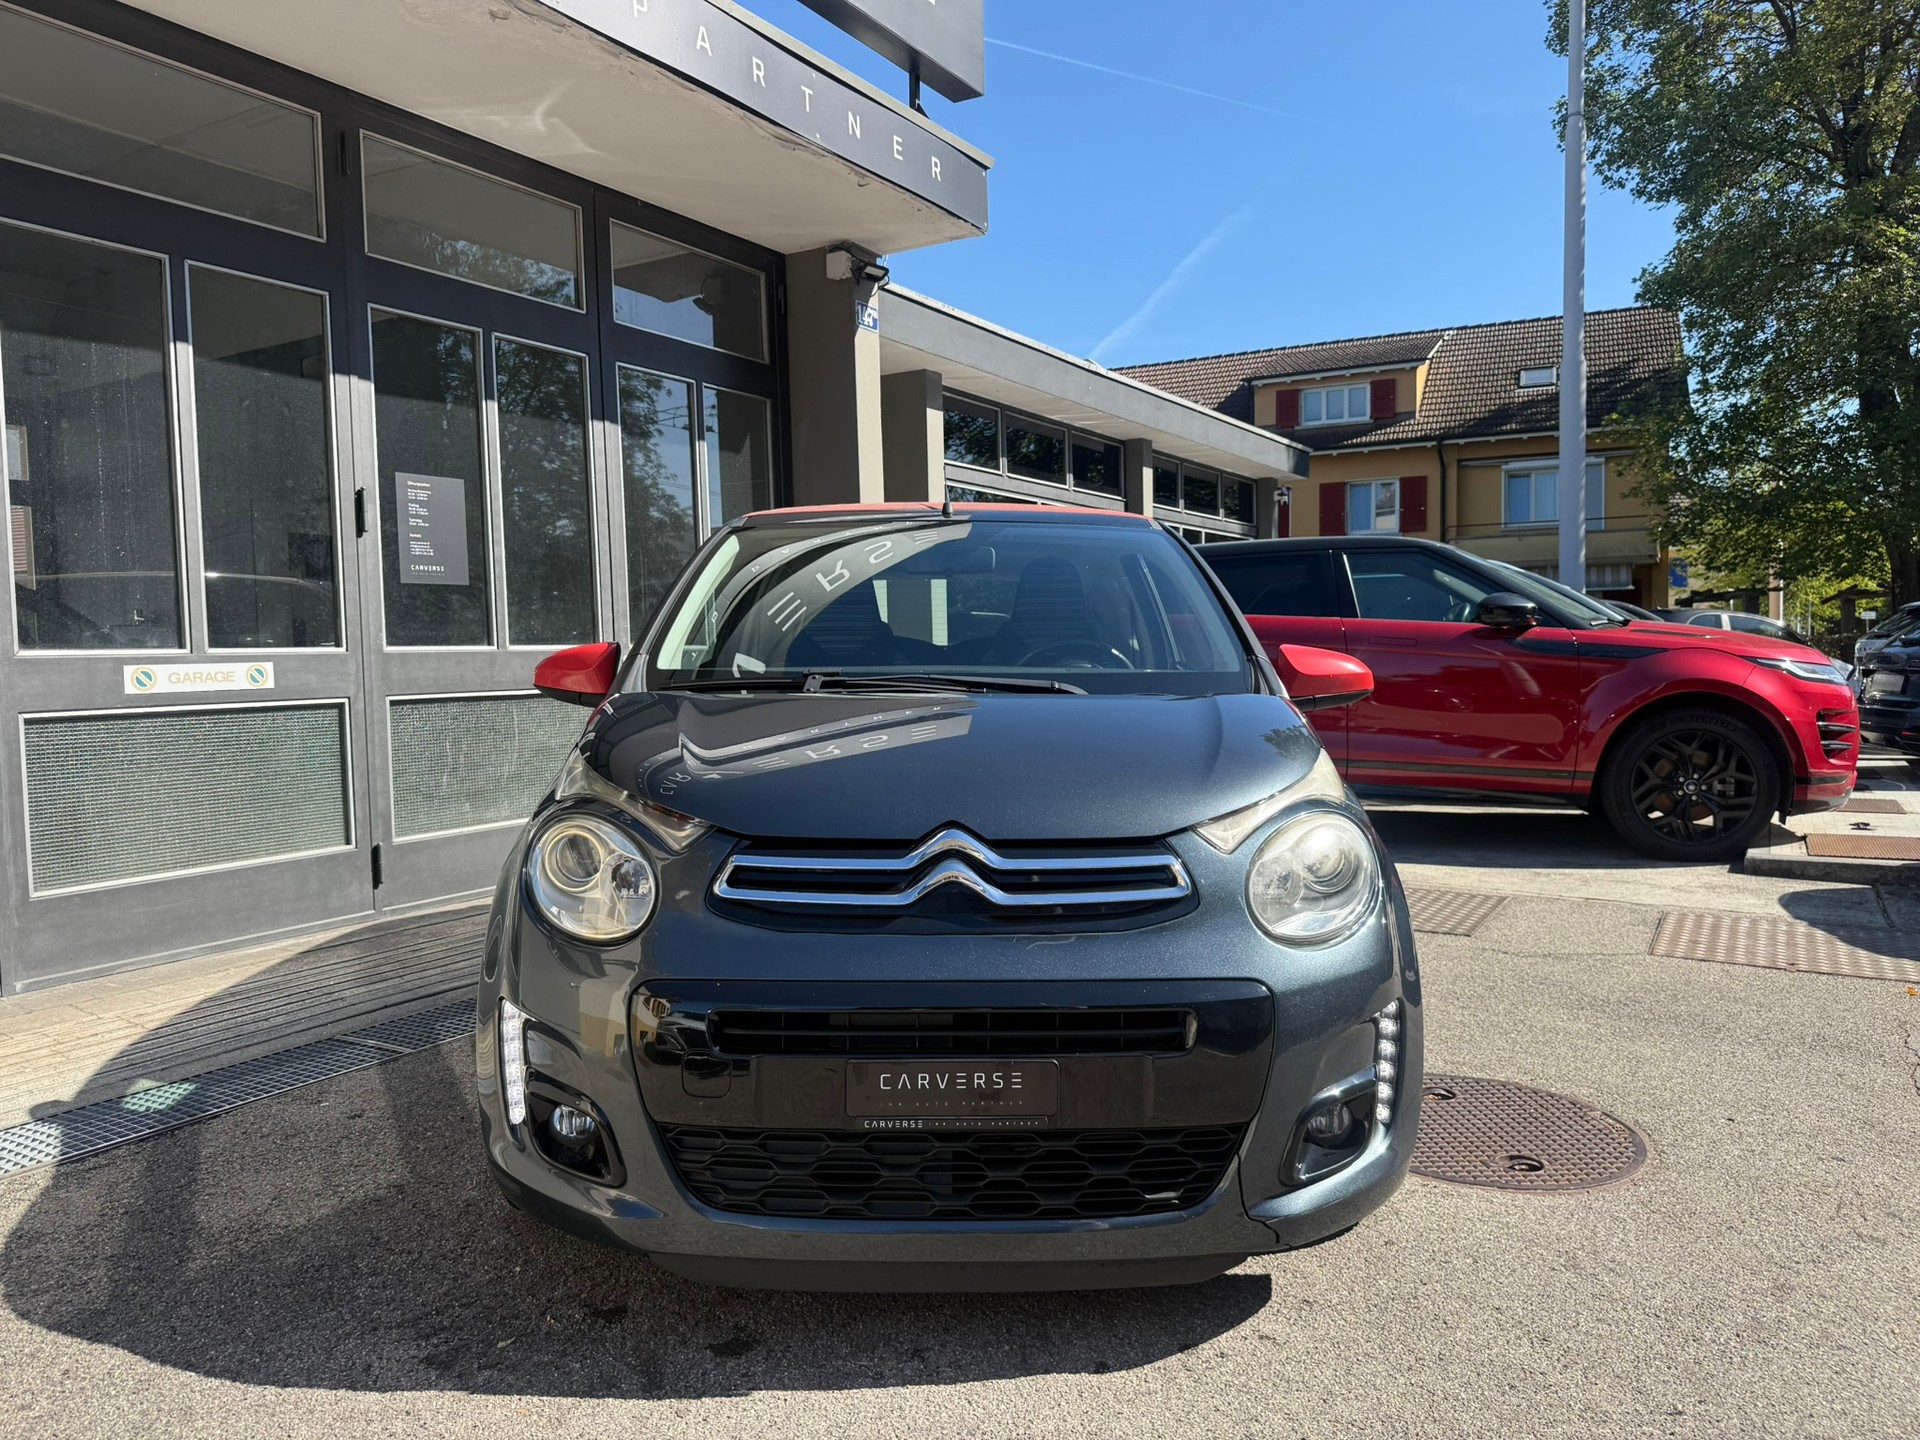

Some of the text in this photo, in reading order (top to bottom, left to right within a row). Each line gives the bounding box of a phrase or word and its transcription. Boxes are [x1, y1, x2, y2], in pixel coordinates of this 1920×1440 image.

[410, 564, 445, 572] CARVERSE
[168, 670, 236, 685] GARAGE
[880, 1072, 1022, 1090] CARVERSE
[864, 1120, 923, 1129] CARVERSE
